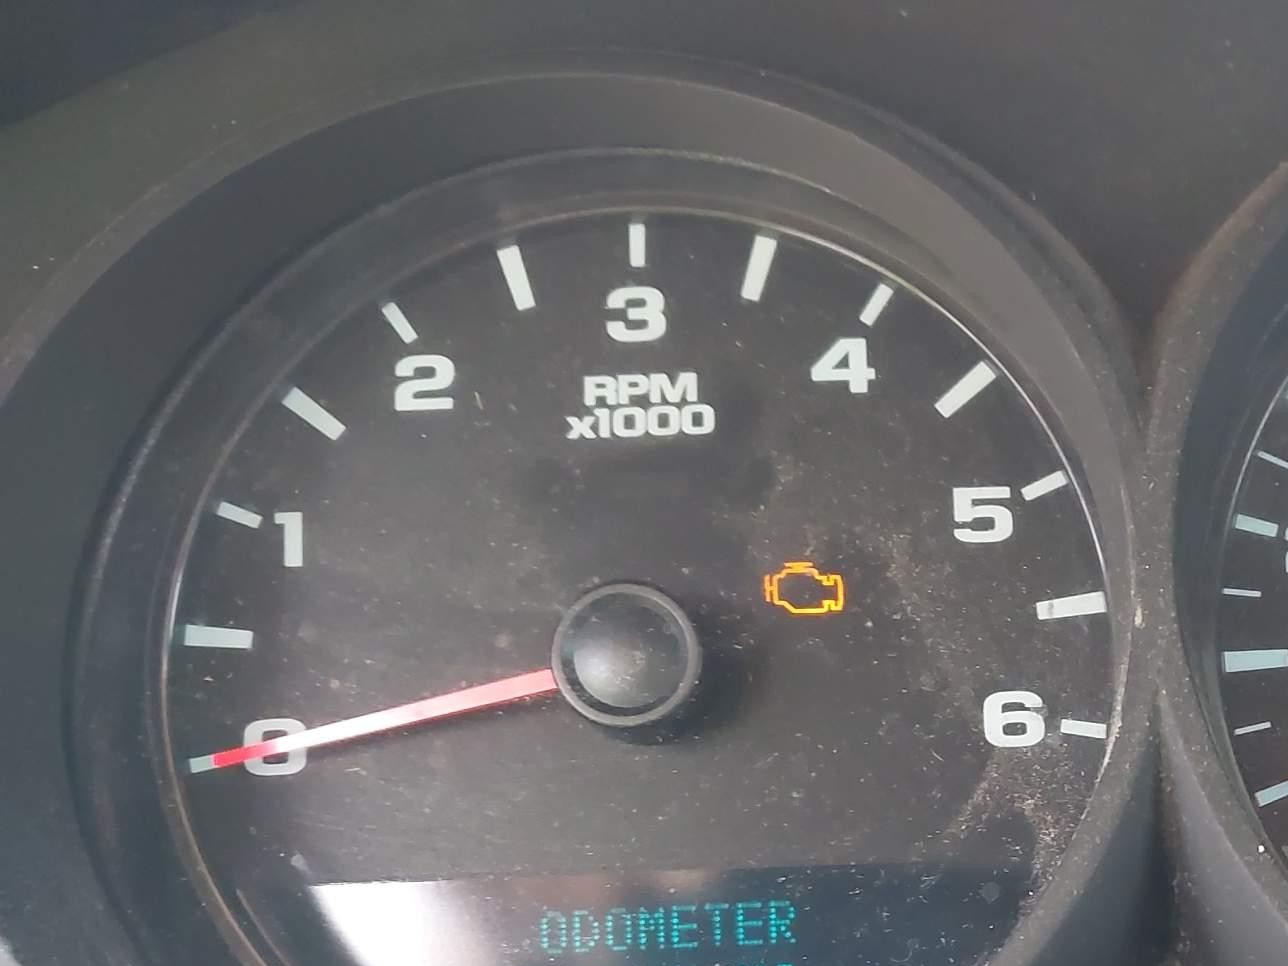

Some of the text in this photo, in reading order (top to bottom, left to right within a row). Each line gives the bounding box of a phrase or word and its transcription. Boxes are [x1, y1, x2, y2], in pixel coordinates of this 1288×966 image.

[605, 286, 666, 343] 3
[394, 354, 455, 412] 2
[583, 371, 698, 407] RPM
[810, 338, 877, 394] 4
[565, 403, 716, 440] x1000
[274, 511, 305, 567] 1
[952, 486, 1014, 544] 5
[242, 717, 309, 777] 0
[983, 691, 1045, 748] 6
[539, 899, 797, 954] ODOMETER
